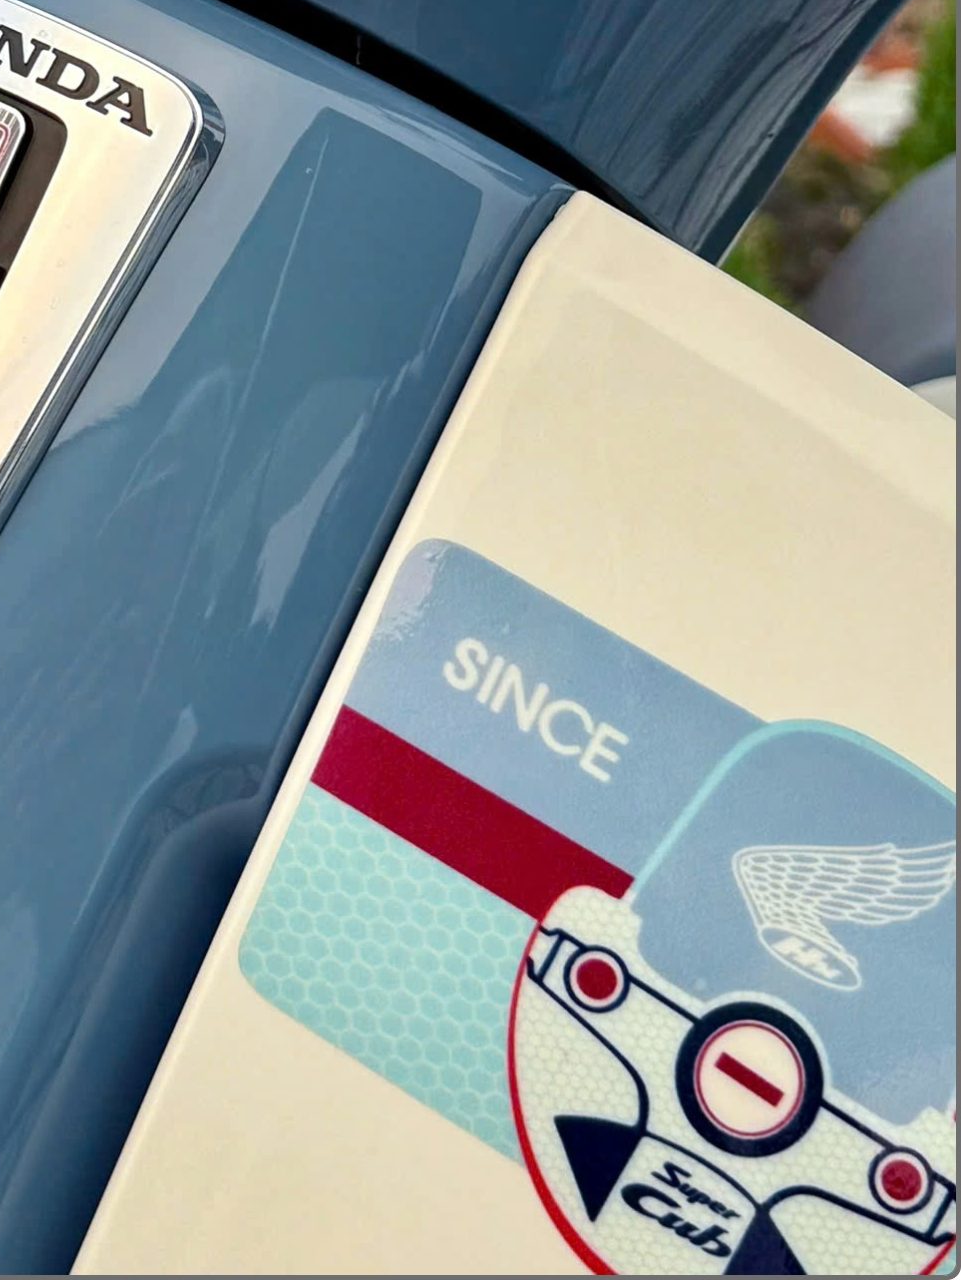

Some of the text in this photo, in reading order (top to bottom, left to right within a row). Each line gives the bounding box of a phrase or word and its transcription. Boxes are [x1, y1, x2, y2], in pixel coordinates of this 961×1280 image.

[442, 637, 630, 783] SINCE
[621, 1183, 732, 1258] Cub
[651, 1161, 741, 1220] Super
